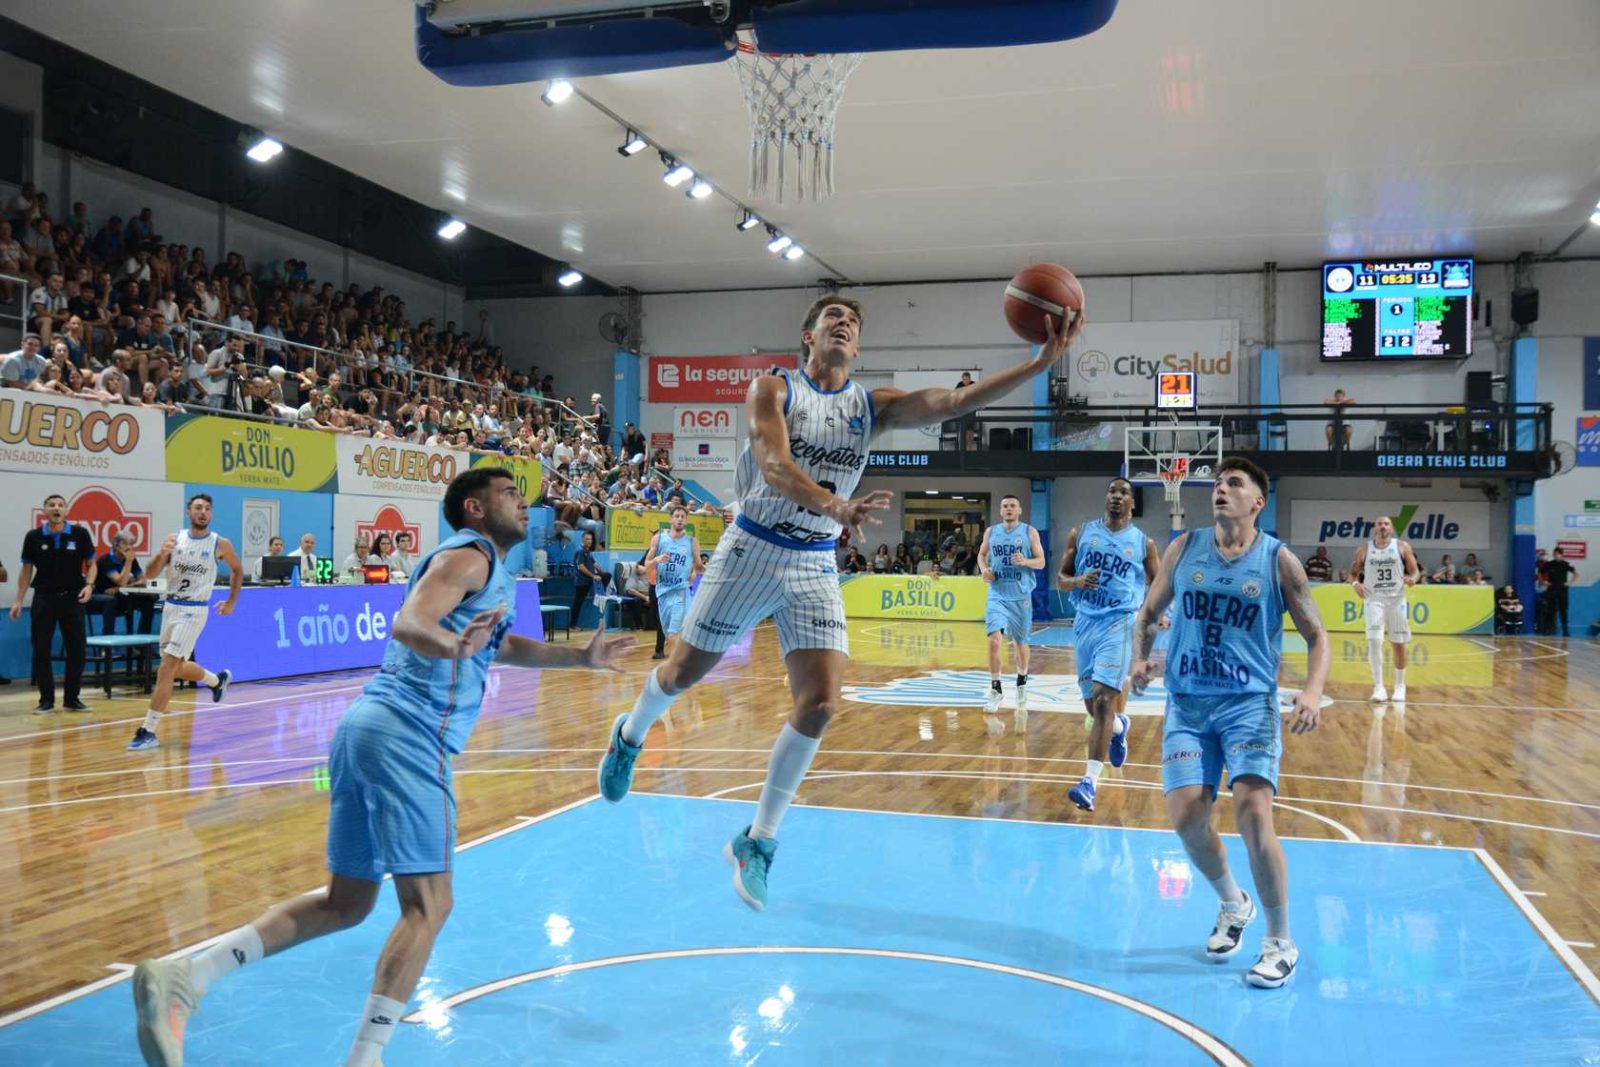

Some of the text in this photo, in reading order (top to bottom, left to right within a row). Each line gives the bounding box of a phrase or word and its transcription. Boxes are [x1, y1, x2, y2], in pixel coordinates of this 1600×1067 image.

[1359, 275, 1374, 286] 11
[1421, 273, 1436, 284] 13
[1384, 336, 1410, 347] 2 2
[685, 365, 702, 381] la
[1161, 375, 1190, 393] 21
[246, 426, 270, 444] DON
[222, 440, 294, 478] BASILIO
[358, 444, 457, 485] AGUERCO
[868, 454, 929, 466] ENIS CLUB
[1377, 455, 1507, 468] OBERA TENIS CLUB
[1319, 505, 1459, 542] petrValle
[316, 560, 332, 580] 22
[665, 563, 676, 572] 10
[1084, 551, 1132, 578] OBERA
[1377, 569, 1392, 581] 33
[178, 579, 191, 592] 2
[907, 580, 931, 590] DON
[881, 589, 955, 612] BASILIO
[1182, 590, 1261, 632] OBERA
[273, 602, 387, 648] 1 año de
[811, 618, 846, 631] SHON
[1205, 623, 1222, 648] 8
[1200, 647, 1226, 660] DON
[1179, 653, 1250, 685] BASILIO
